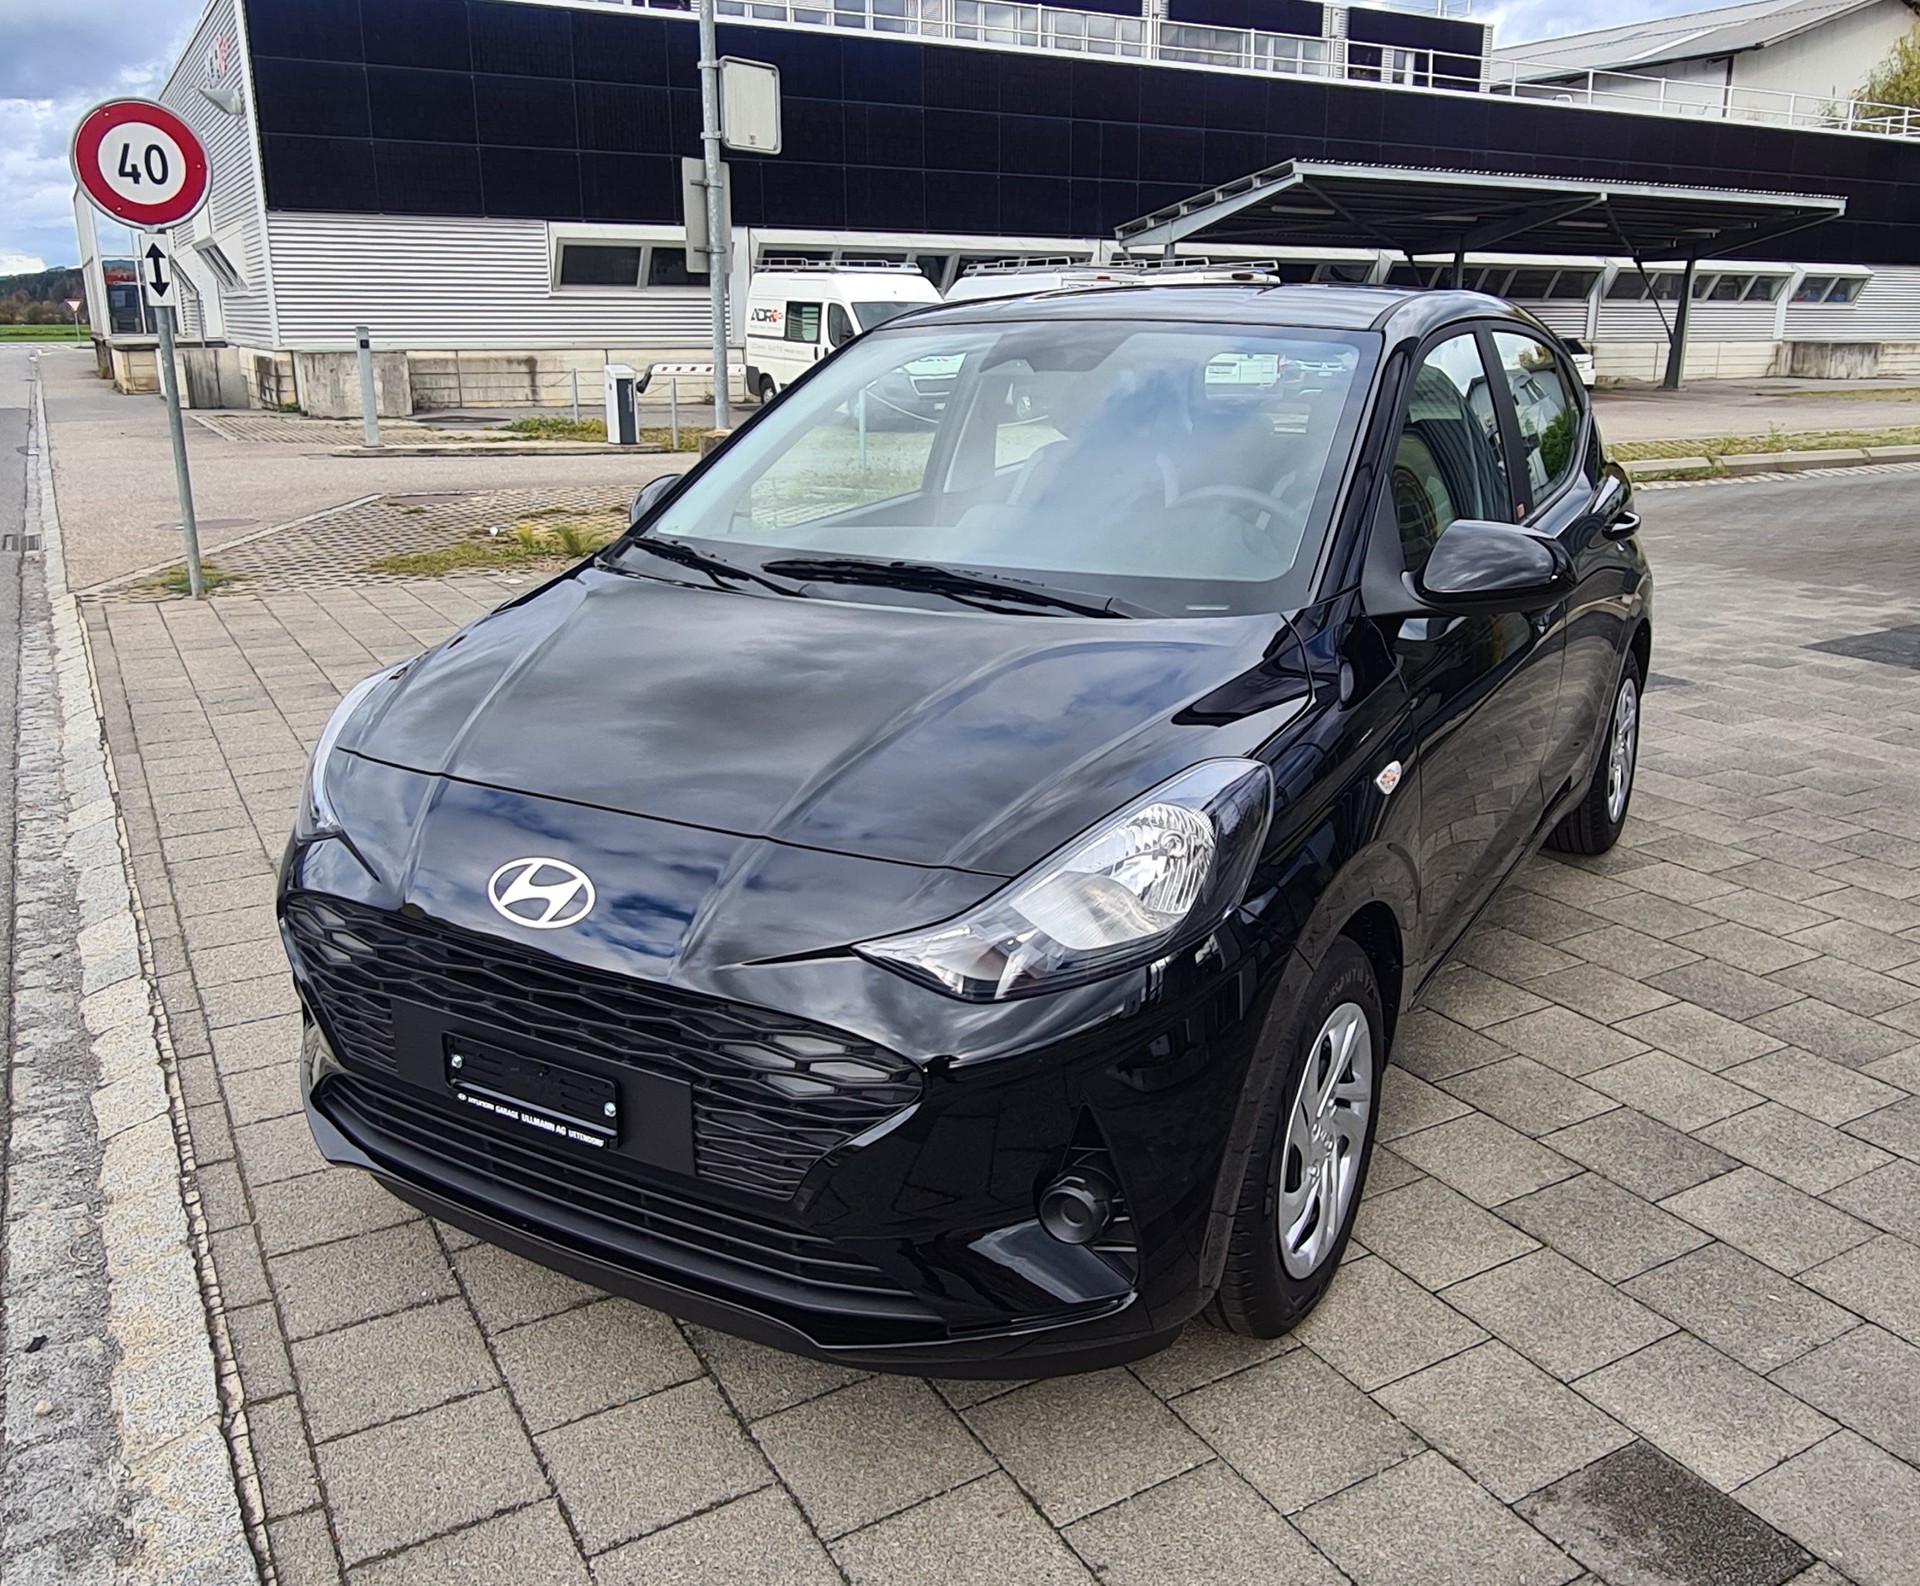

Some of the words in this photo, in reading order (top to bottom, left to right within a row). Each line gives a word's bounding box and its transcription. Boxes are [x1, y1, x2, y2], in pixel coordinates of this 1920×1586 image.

[118, 143, 169, 185] 40
[495, 1105, 519, 1119] GARAGE
[521, 1113, 555, 1132] ULLMANN
[556, 1124, 567, 1136] AG
